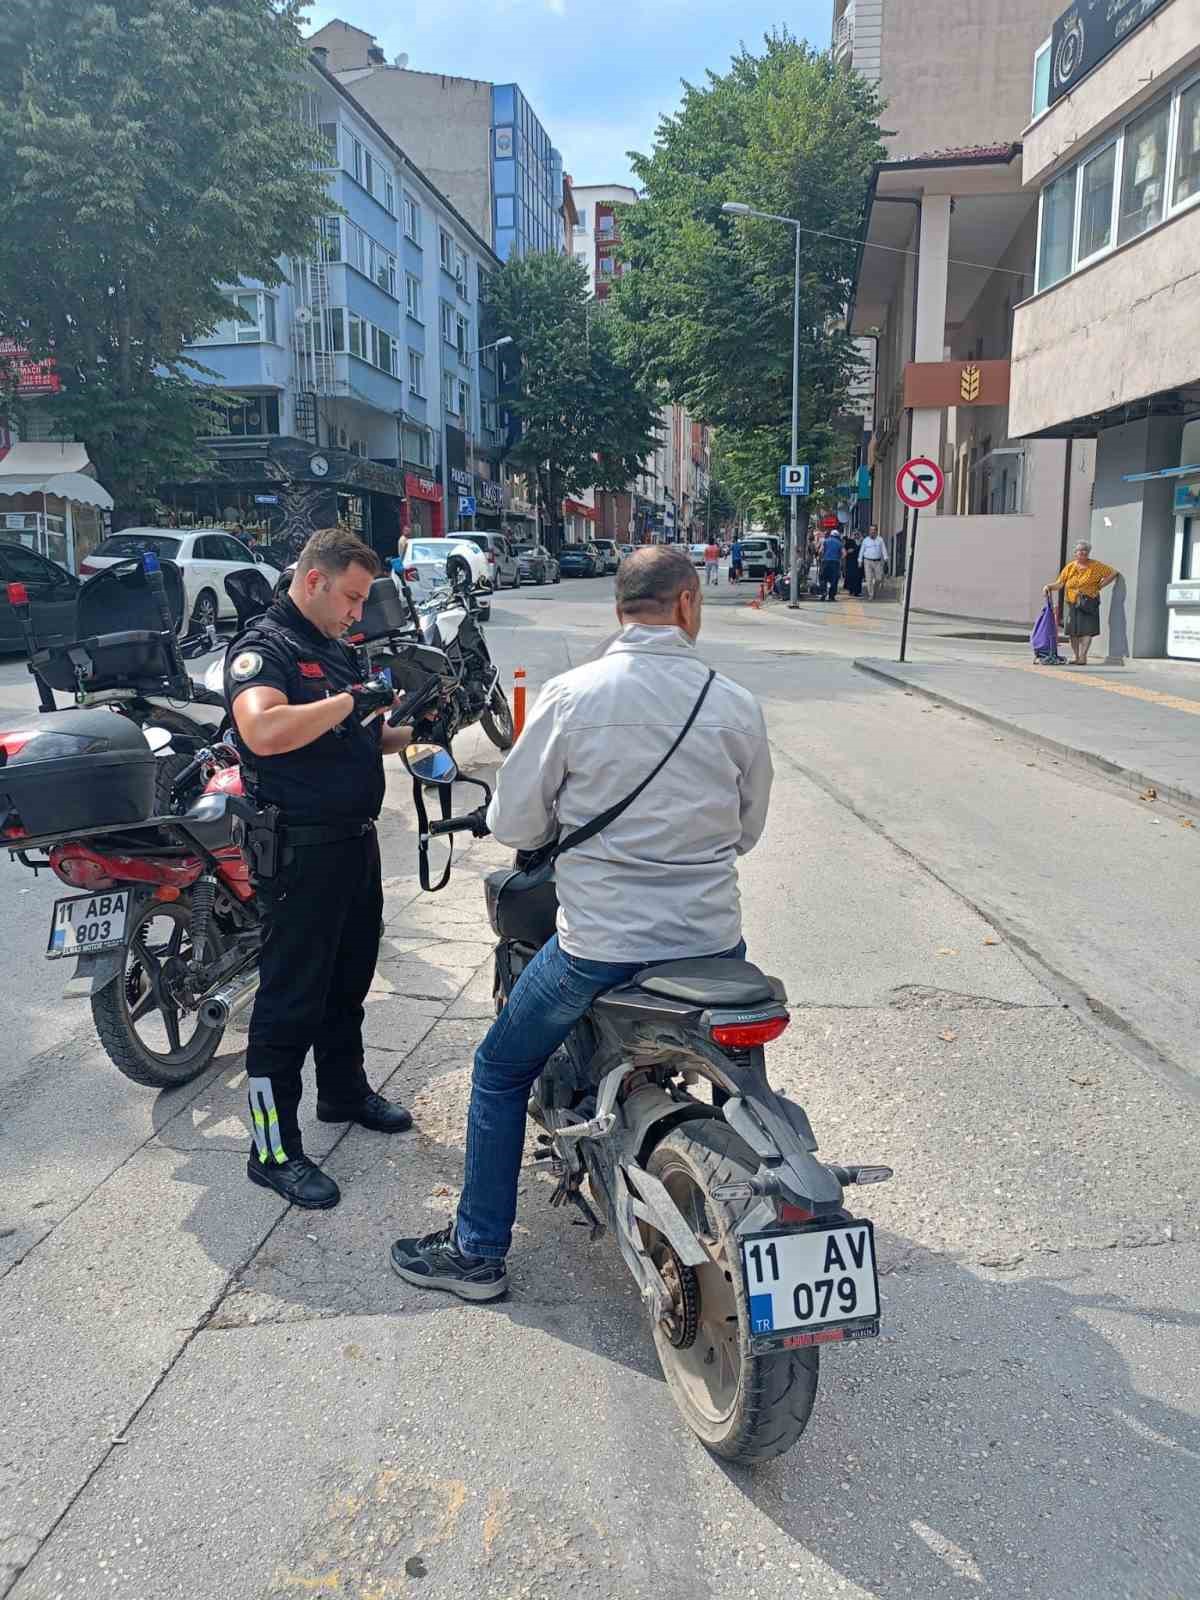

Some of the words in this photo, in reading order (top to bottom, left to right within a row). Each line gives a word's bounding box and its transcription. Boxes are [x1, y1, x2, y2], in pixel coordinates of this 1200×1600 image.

[790, 471, 801, 482] D
[459, 498, 468, 511] P
[59, 903, 73, 924] 11
[86, 895, 125, 918] ABA
[76, 920, 111, 943] 803
[750, 1243, 780, 1282] 11
[823, 1231, 866, 1273] AV
[793, 1276, 857, 1321] 079
[756, 1319, 770, 1331] TR
